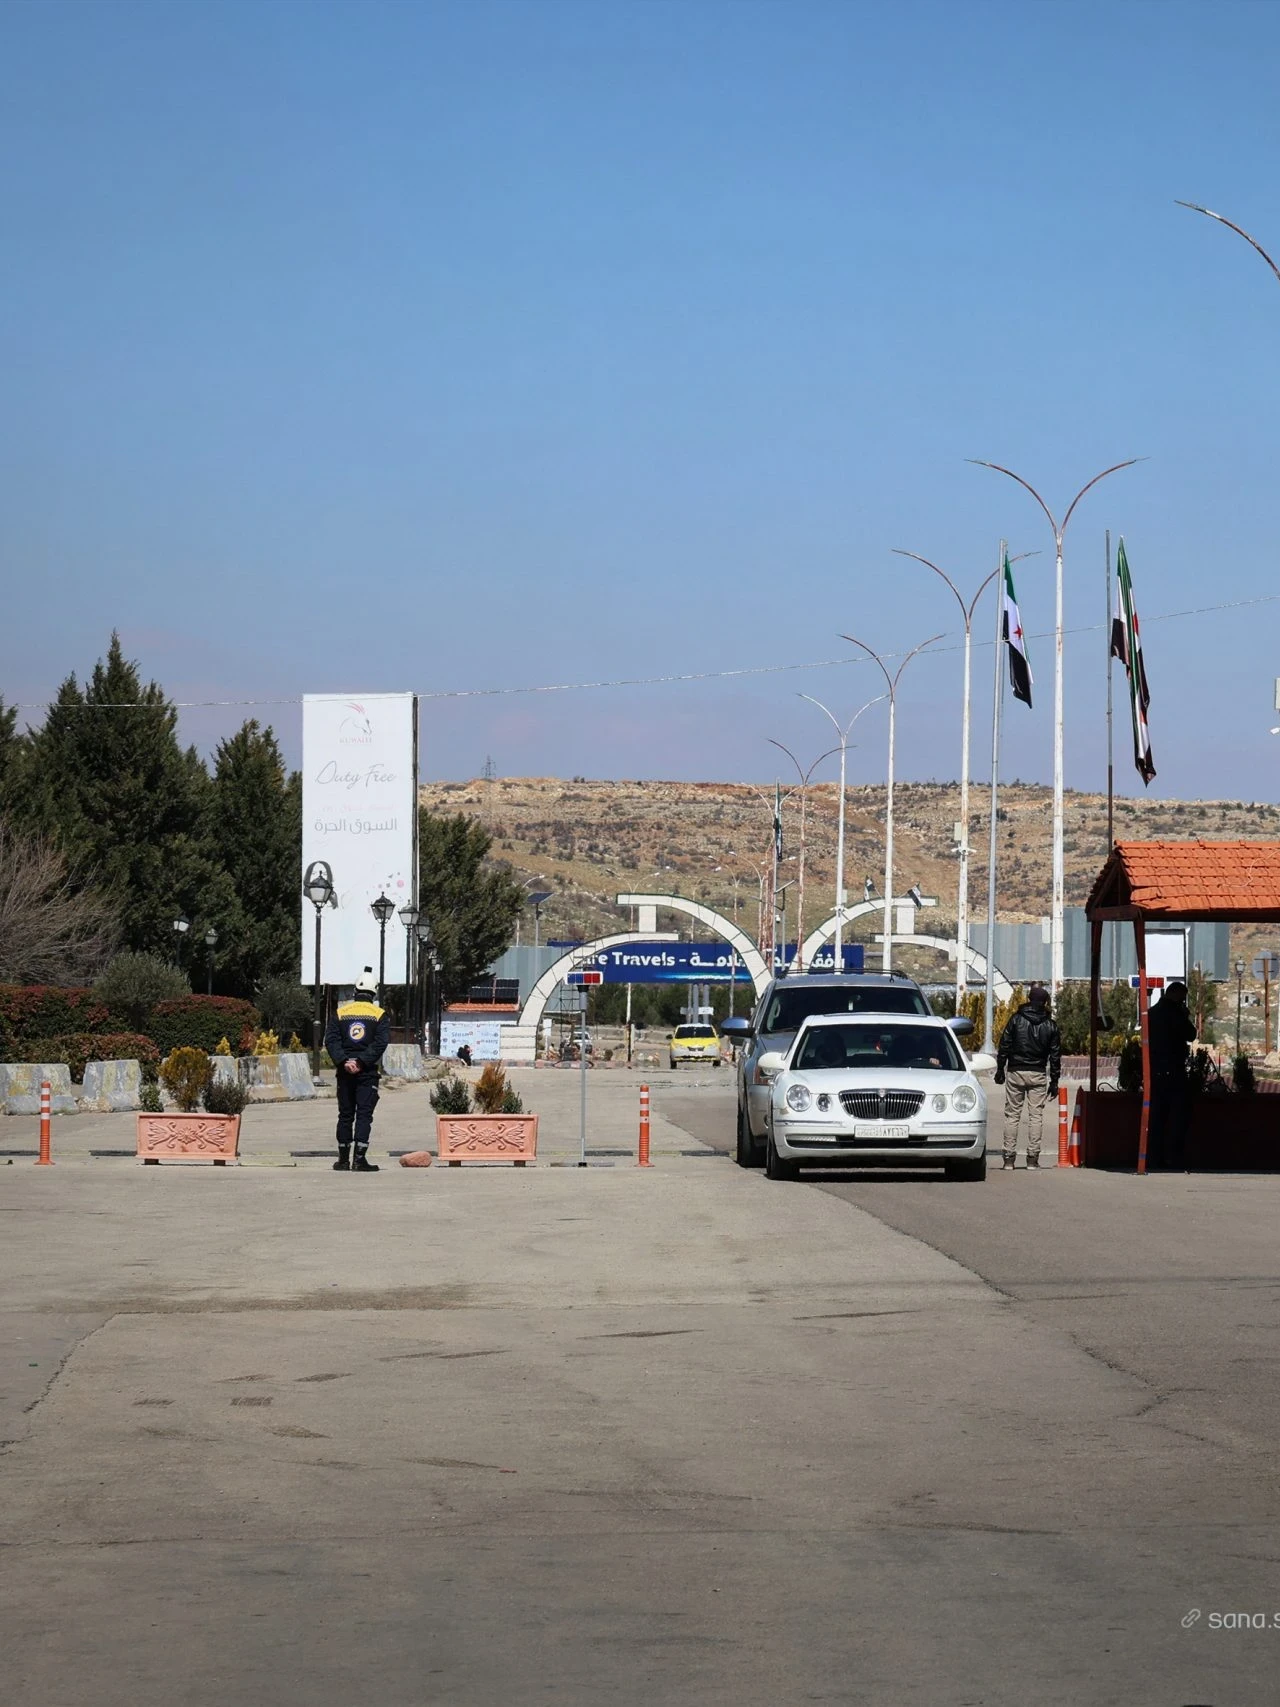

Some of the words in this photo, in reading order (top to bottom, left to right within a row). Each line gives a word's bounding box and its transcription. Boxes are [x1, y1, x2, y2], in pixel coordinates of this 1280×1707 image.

[315, 760, 361, 789] Duty
[363, 763, 397, 788] Free
[314, 817, 346, 834] الحرة
[350, 817, 398, 835] السوق
[612, 952, 675, 966] Travels
